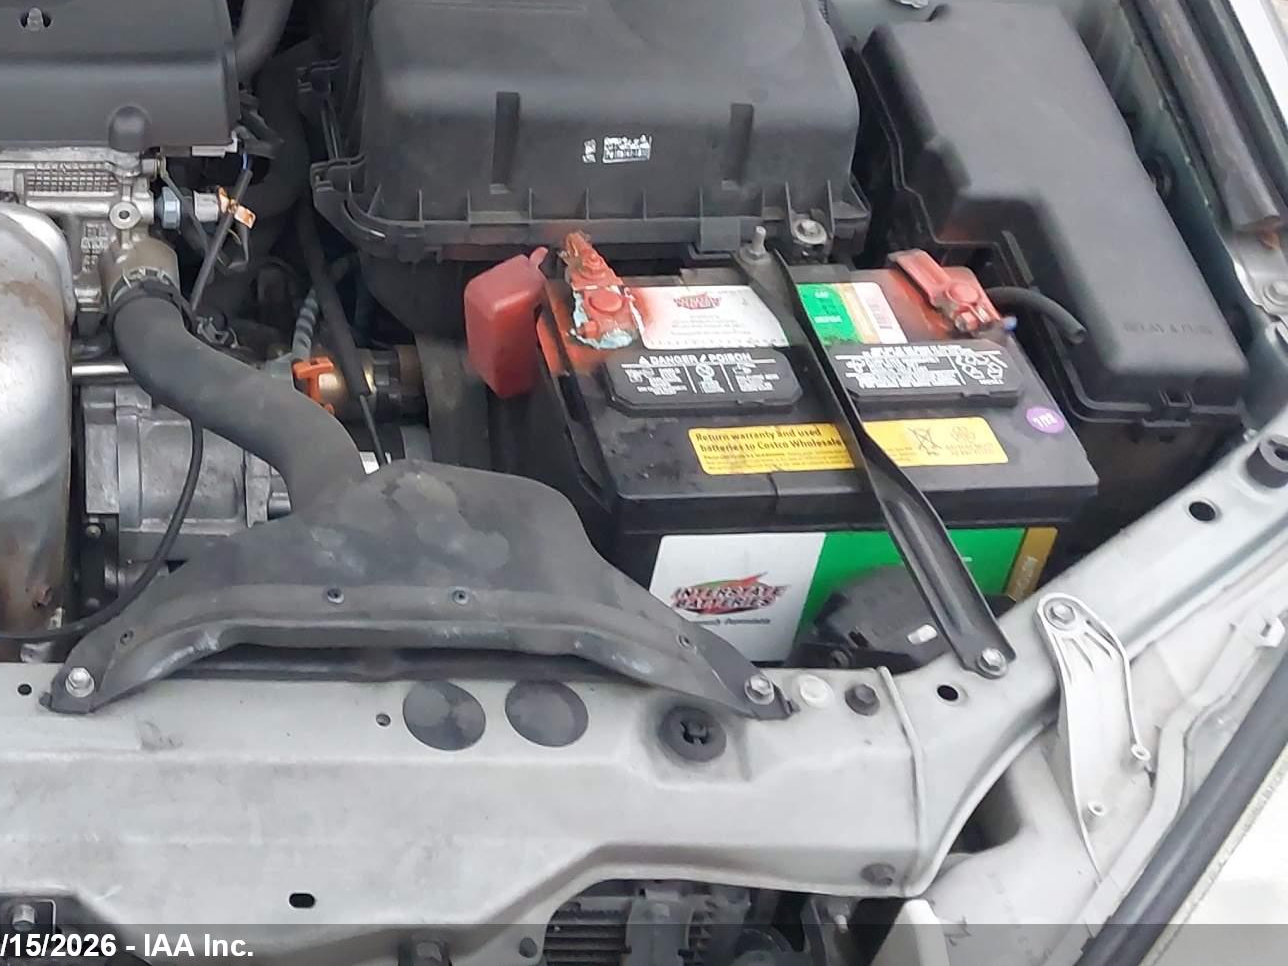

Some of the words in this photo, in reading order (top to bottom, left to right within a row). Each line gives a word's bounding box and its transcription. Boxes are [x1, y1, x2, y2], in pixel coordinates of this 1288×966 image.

[649, 354, 699, 366] DANGER
[707, 352, 753, 365] POISON
[695, 432, 728, 442] Return
[732, 430, 775, 443] warranty
[777, 428, 796, 438] and
[797, 427, 822, 437] used
[700, 441, 744, 453] batteries
[746, 442, 756, 451] to
[757, 440, 789, 450] Costco
[790, 437, 843, 449] Wholesale
[673, 586, 788, 600] INTERSTATE
[673, 597, 775, 611] BATTERIES
